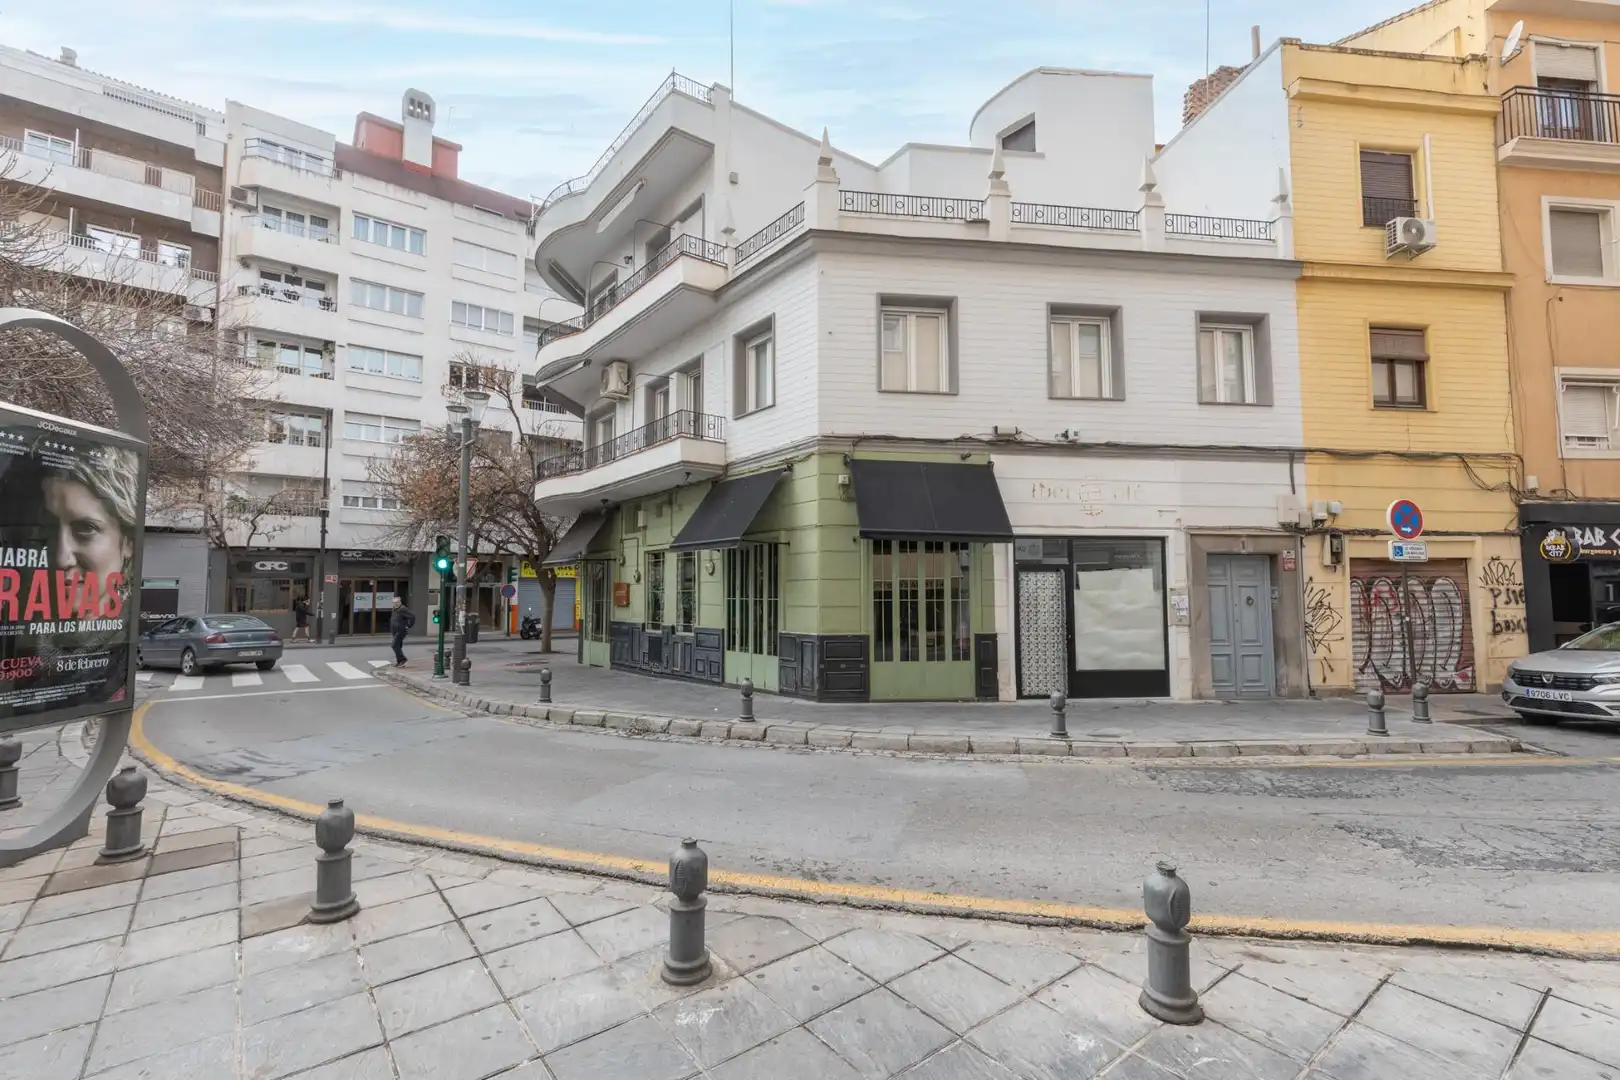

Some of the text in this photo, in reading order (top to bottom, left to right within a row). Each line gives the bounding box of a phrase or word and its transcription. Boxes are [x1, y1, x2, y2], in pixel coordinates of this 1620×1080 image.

[37, 420, 78, 437] JCDecaux
[0, 546, 48, 568] ABRÁ
[0, 568, 125, 622] RAVAS
[29, 621, 56, 635] PARA
[58, 620, 76, 634] LOS
[78, 618, 123, 632] MALVADOS
[1, 655, 42, 670] CUEVA
[56, 657, 109, 673] 8 de febrero
[1530, 690, 1570, 701] 9706 LVC
